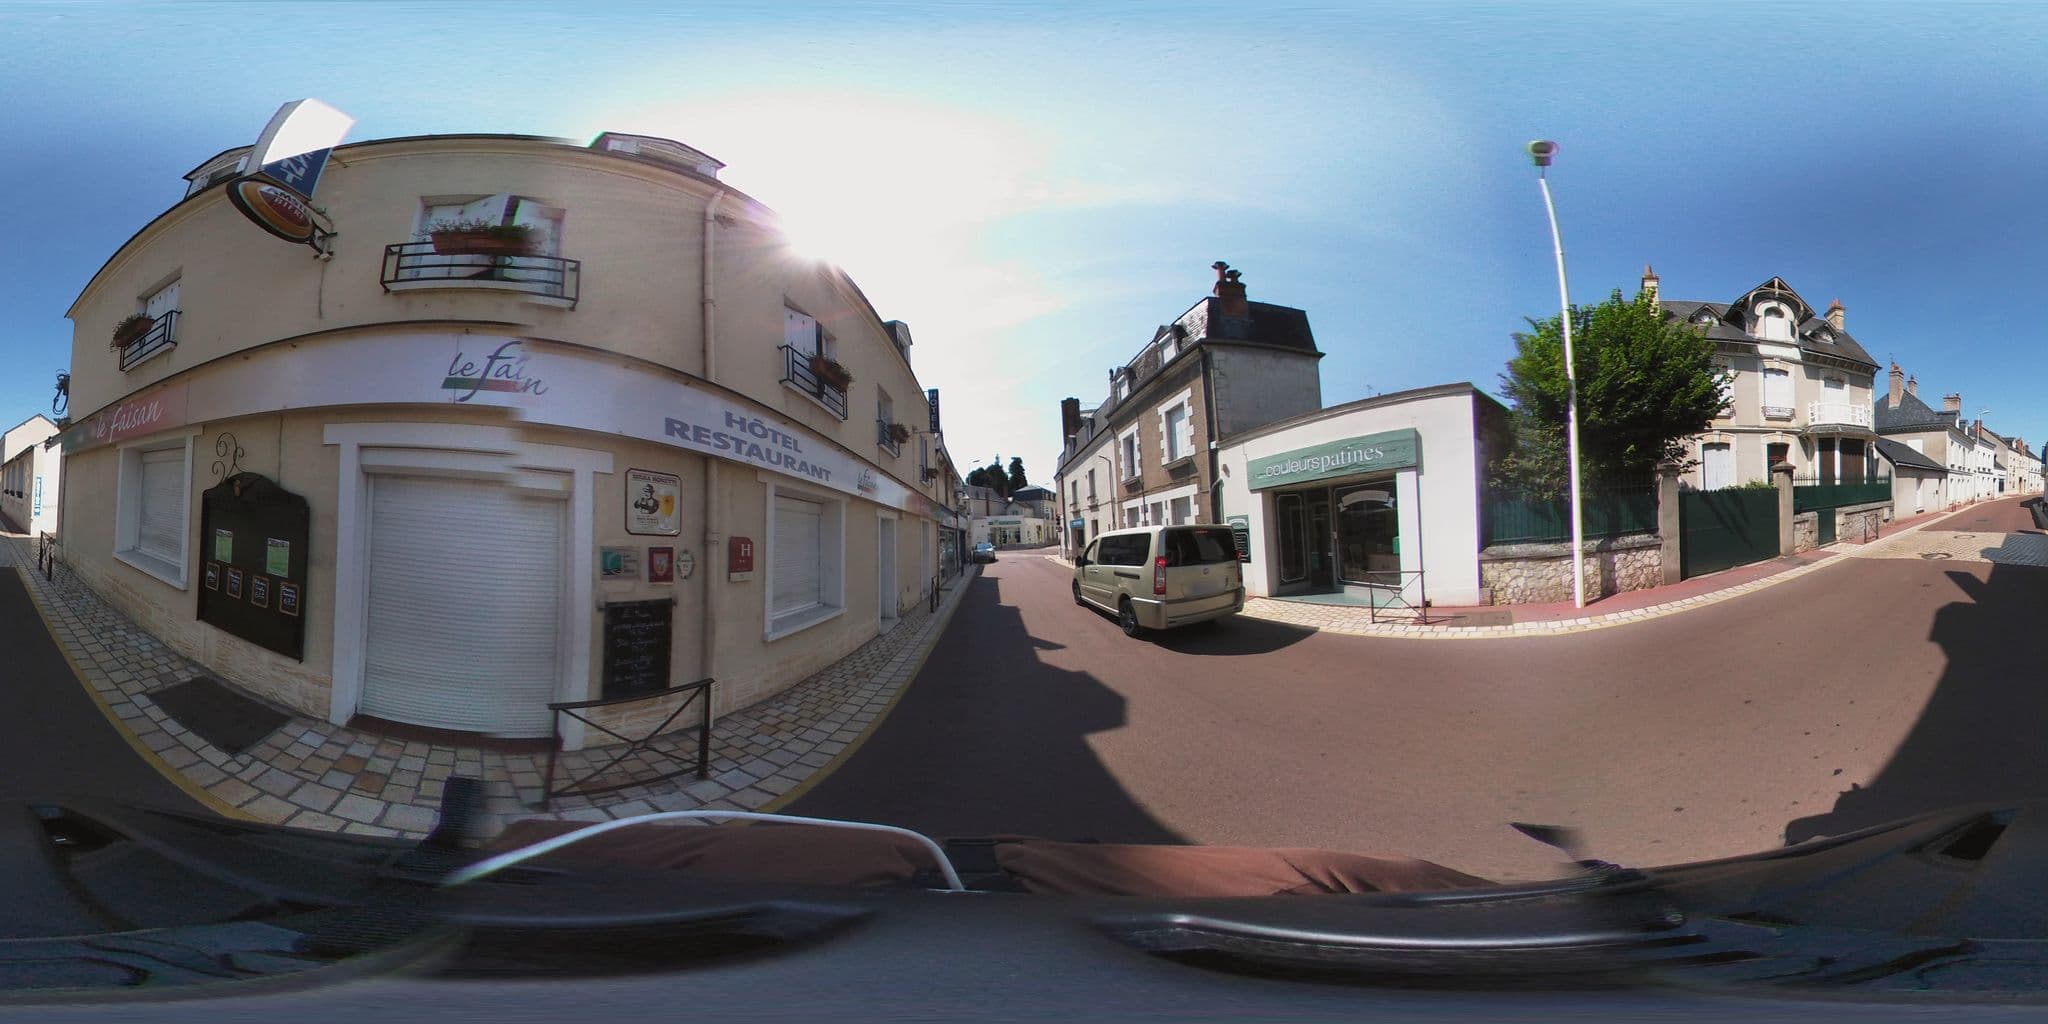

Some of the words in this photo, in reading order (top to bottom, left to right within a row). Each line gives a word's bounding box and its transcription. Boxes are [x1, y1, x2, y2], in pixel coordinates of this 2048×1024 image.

[448, 352, 480, 377] le
[664, 416, 832, 482] RESTAURANT
[724, 410, 803, 454] HÔTEL
[741, 543, 751, 557] H
